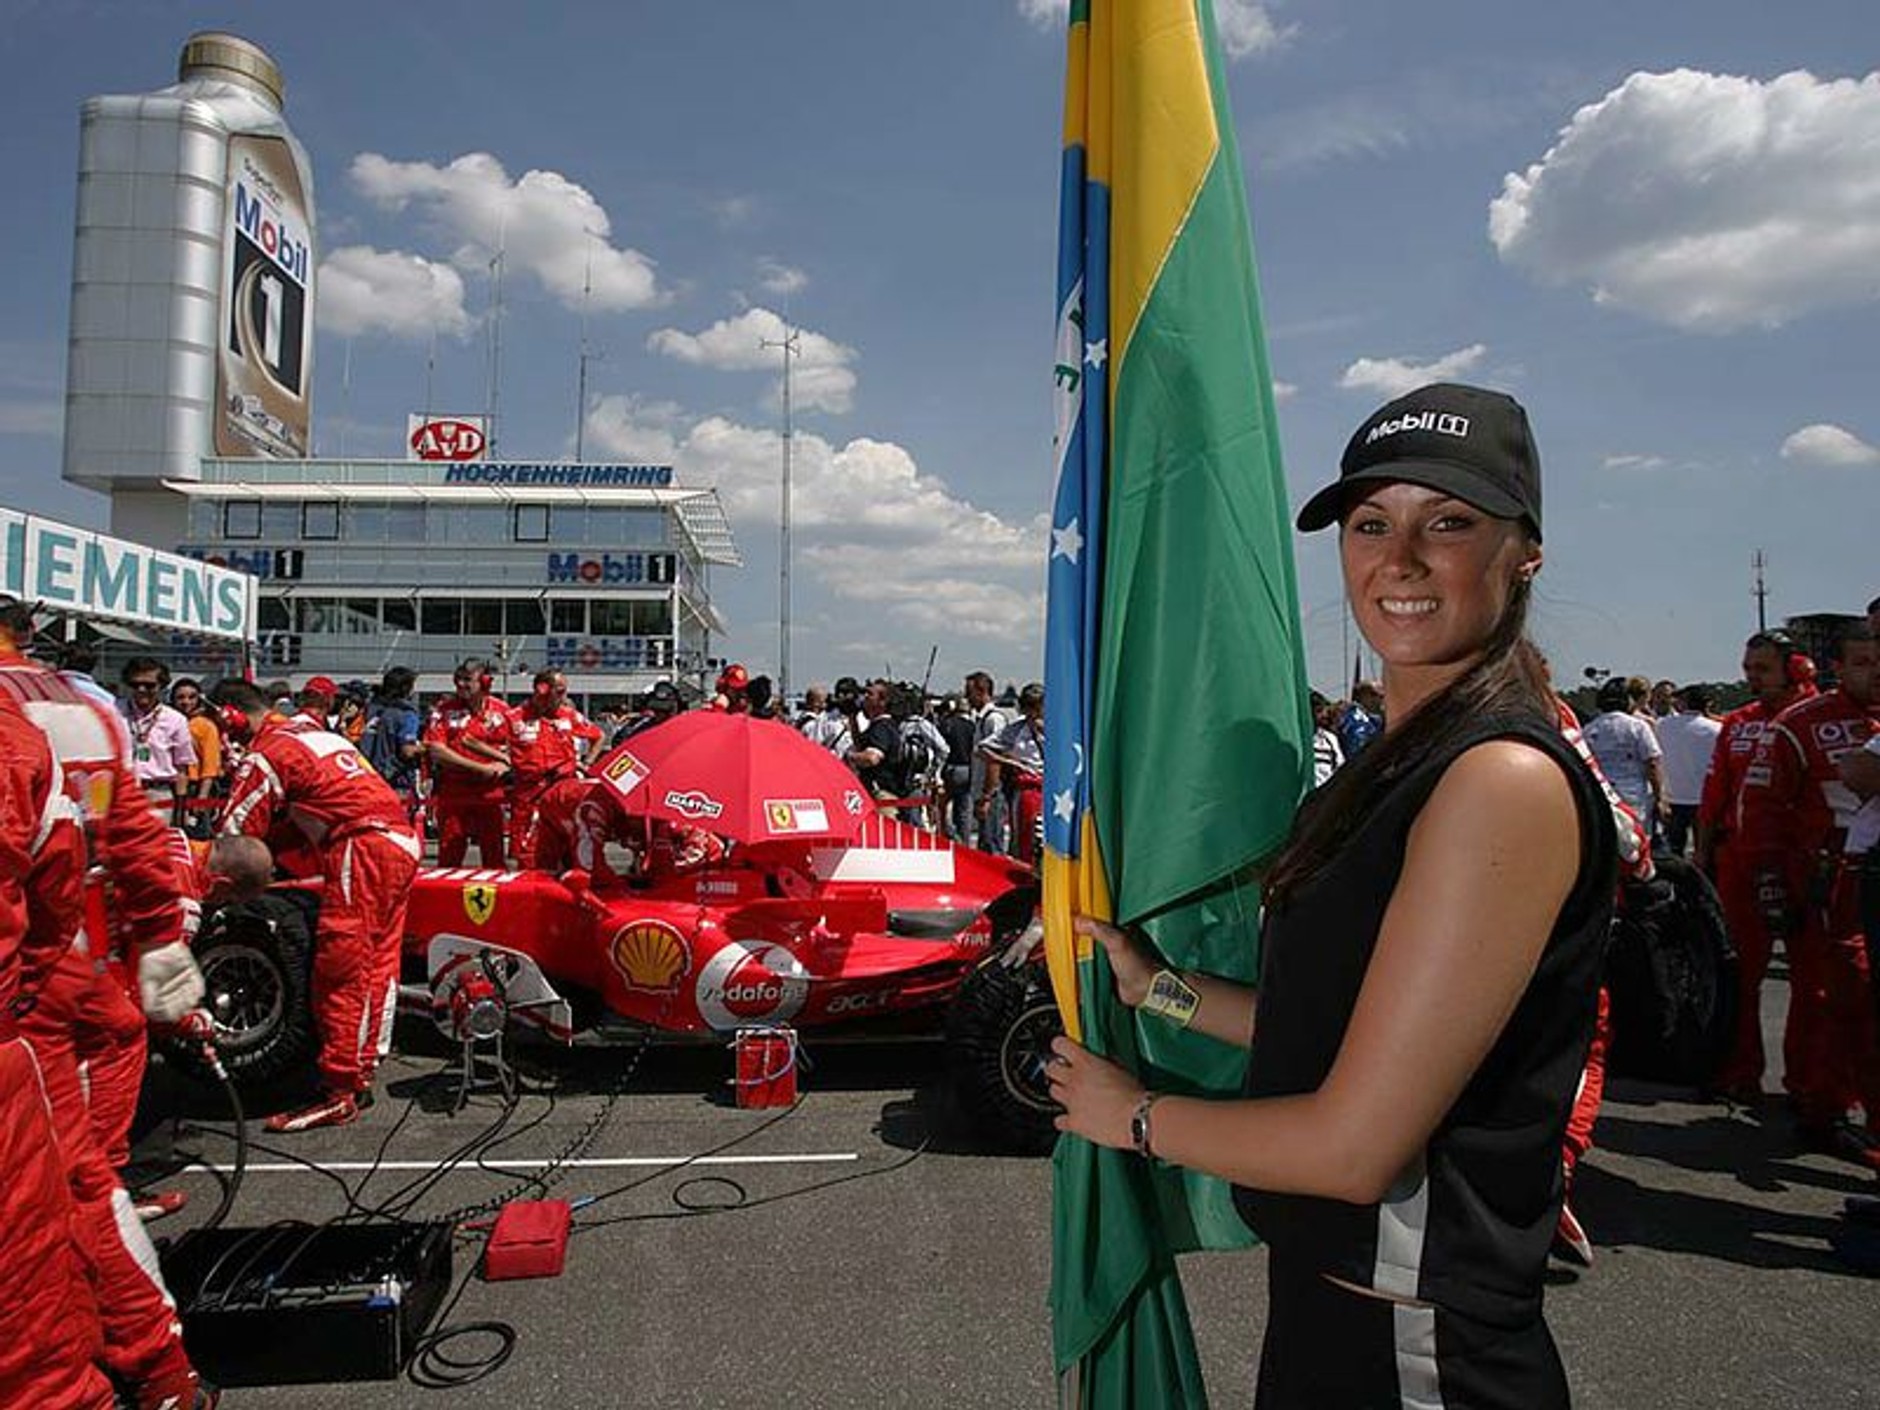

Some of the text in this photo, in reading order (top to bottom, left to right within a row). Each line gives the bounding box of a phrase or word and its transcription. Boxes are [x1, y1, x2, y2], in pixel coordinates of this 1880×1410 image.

[235, 182, 307, 285] Mobil
[261, 274, 283, 368] 1
[1365, 411, 1436, 445] Mobil
[446, 464, 672, 485] HOCKENHEIMRING
[6, 522, 242, 631] IEMENS
[548, 554, 642, 583] Mobil
